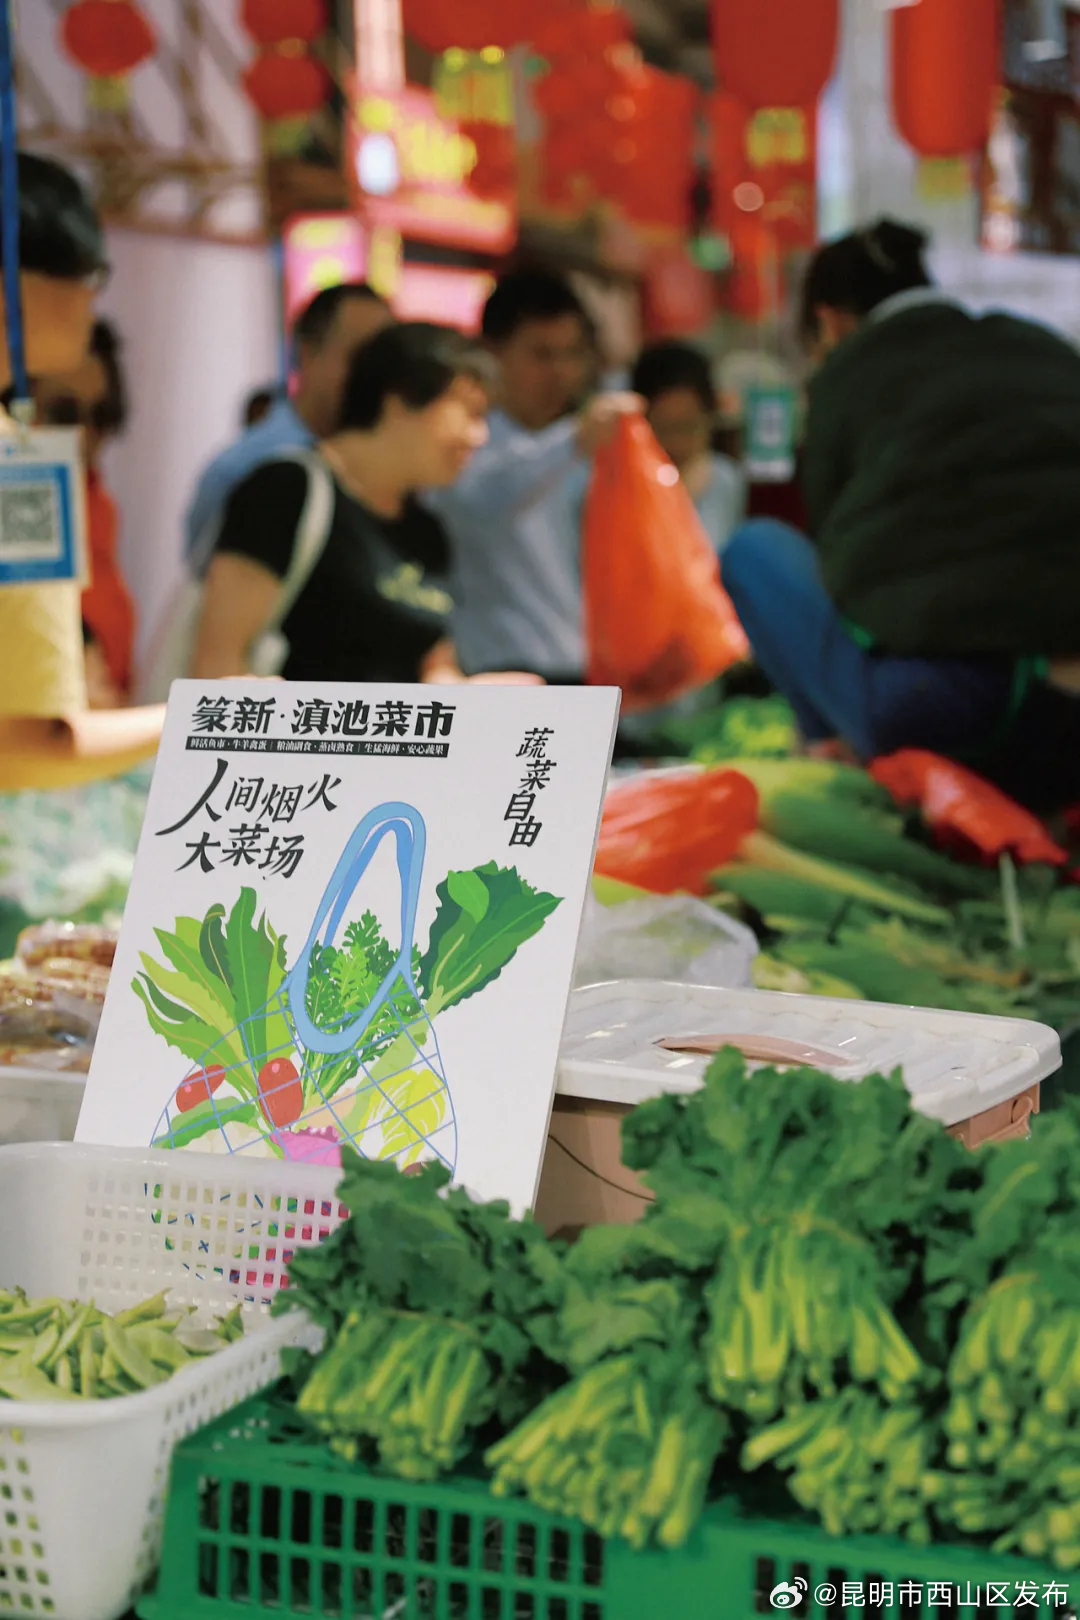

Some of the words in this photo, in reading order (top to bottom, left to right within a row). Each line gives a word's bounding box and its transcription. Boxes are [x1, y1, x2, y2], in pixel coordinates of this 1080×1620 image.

[191, 695, 457, 739] 篆新·滇池菜市
[154, 757, 342, 836] 人间烟火
[503, 726, 558, 848] 蔬菜自由
[174, 823, 305, 879] 大菜场
